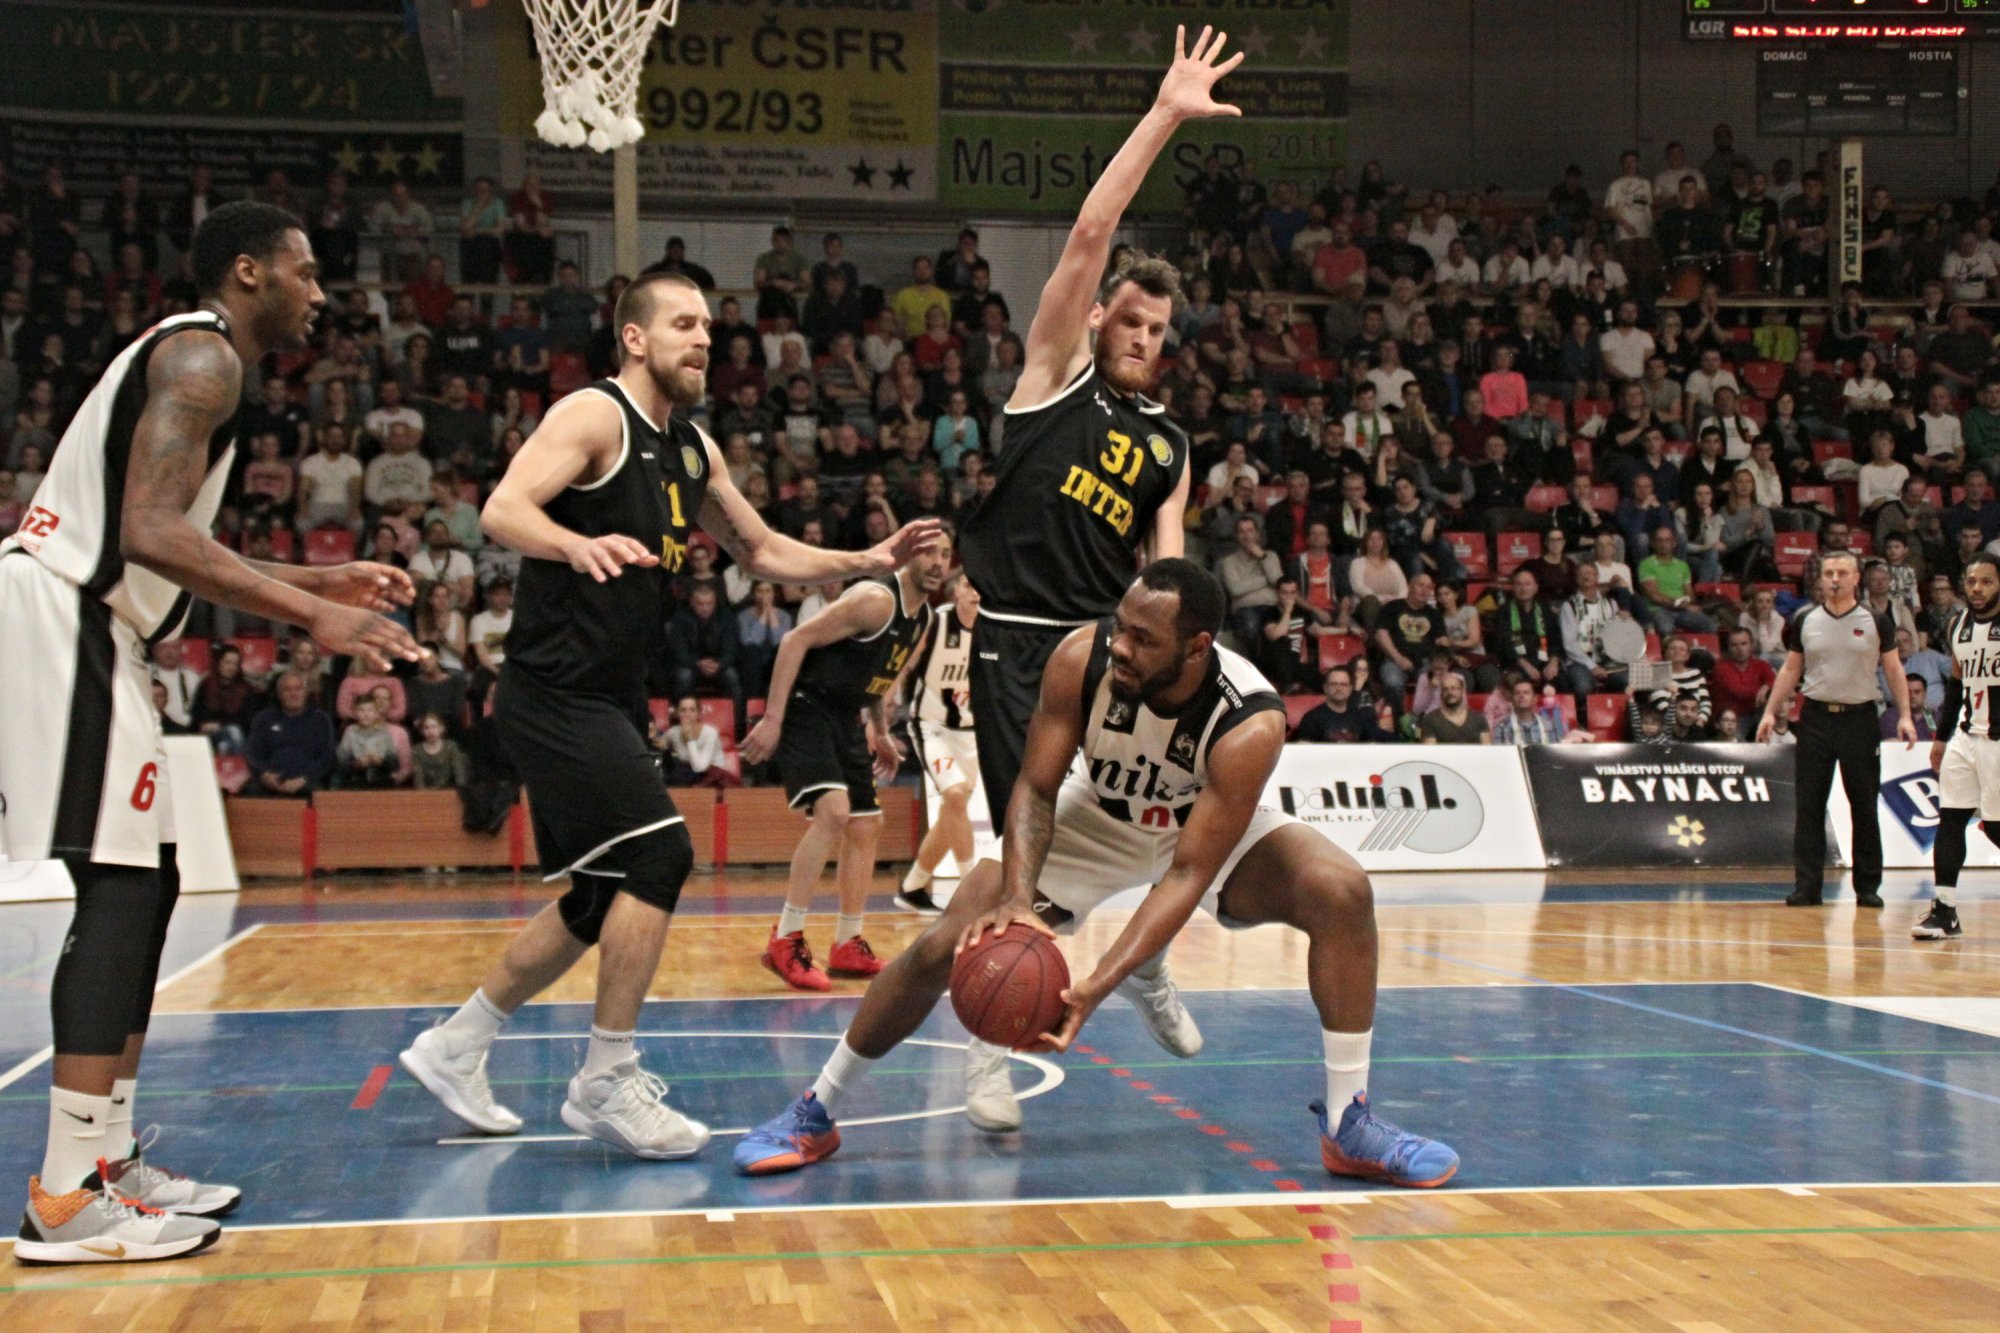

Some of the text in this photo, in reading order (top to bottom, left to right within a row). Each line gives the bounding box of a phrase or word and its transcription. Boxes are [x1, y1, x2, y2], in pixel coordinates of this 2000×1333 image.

[1688, 21, 1725, 35] LGR
[751, 15, 908, 74] ČSFR
[1909, 50, 1953, 61] HOSTIA
[1100, 430, 1144, 487] 31
[1060, 465, 1134, 537] INTER
[1216, 674, 1244, 709] brose
[1974, 690, 1984, 710] 1
[932, 757, 955, 774] 17
[1090, 755, 1203, 803] nik
[1595, 762, 1745, 776] VINÁRSTVO NAŠICH OTCOV
[130, 763, 157, 814] 6
[1580, 777, 1771, 803] BAYNACH
